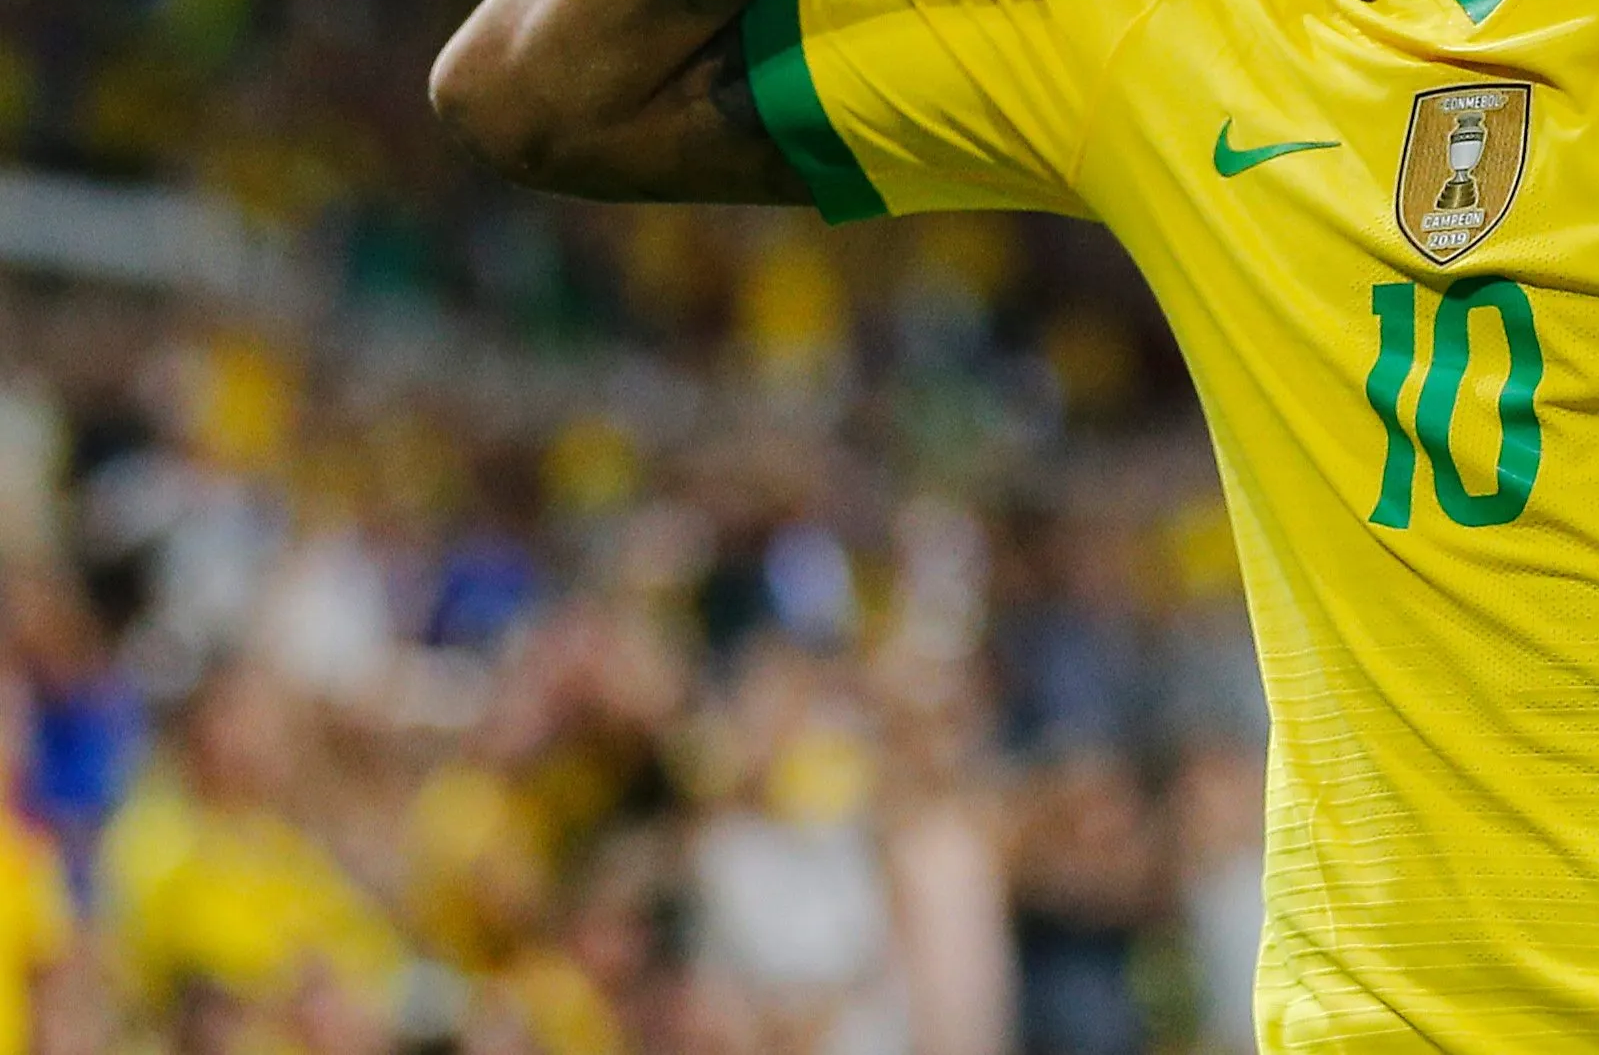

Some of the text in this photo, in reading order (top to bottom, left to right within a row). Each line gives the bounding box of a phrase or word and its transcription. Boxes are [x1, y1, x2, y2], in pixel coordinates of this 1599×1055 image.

[1443, 94, 1501, 110] CONMEBOL
[1429, 232, 1467, 248] 2019
[1366, 275, 1543, 529] 10
